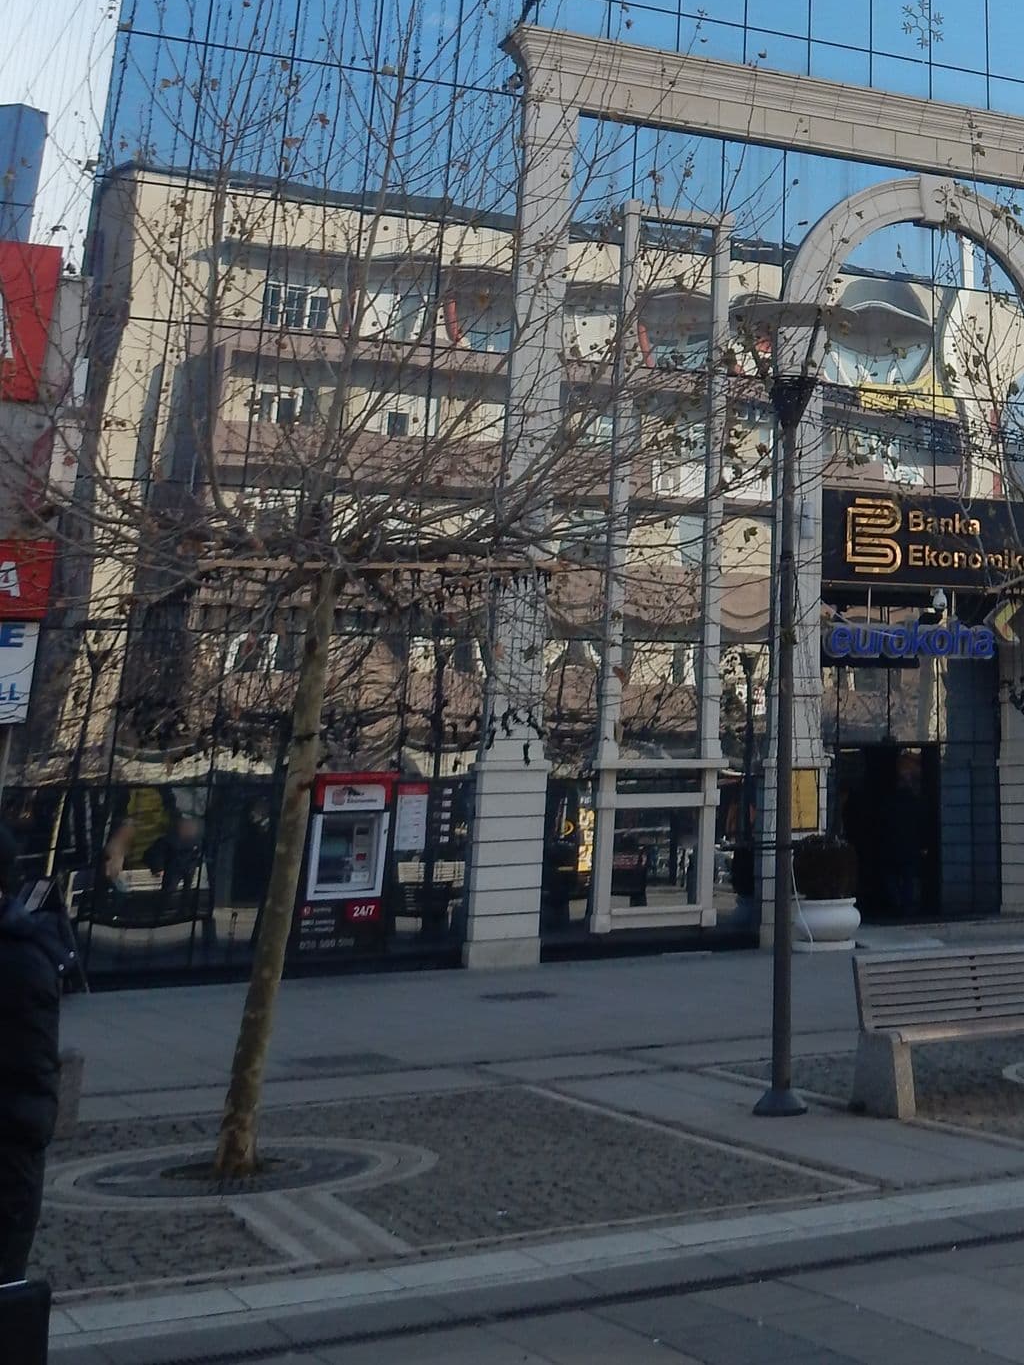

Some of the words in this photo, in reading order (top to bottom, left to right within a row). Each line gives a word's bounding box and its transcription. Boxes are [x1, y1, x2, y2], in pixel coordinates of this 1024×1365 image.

[908, 510, 981, 536] Banka
[828, 620, 996, 658] eurokoha
[352, 905, 376, 917] 24/7
